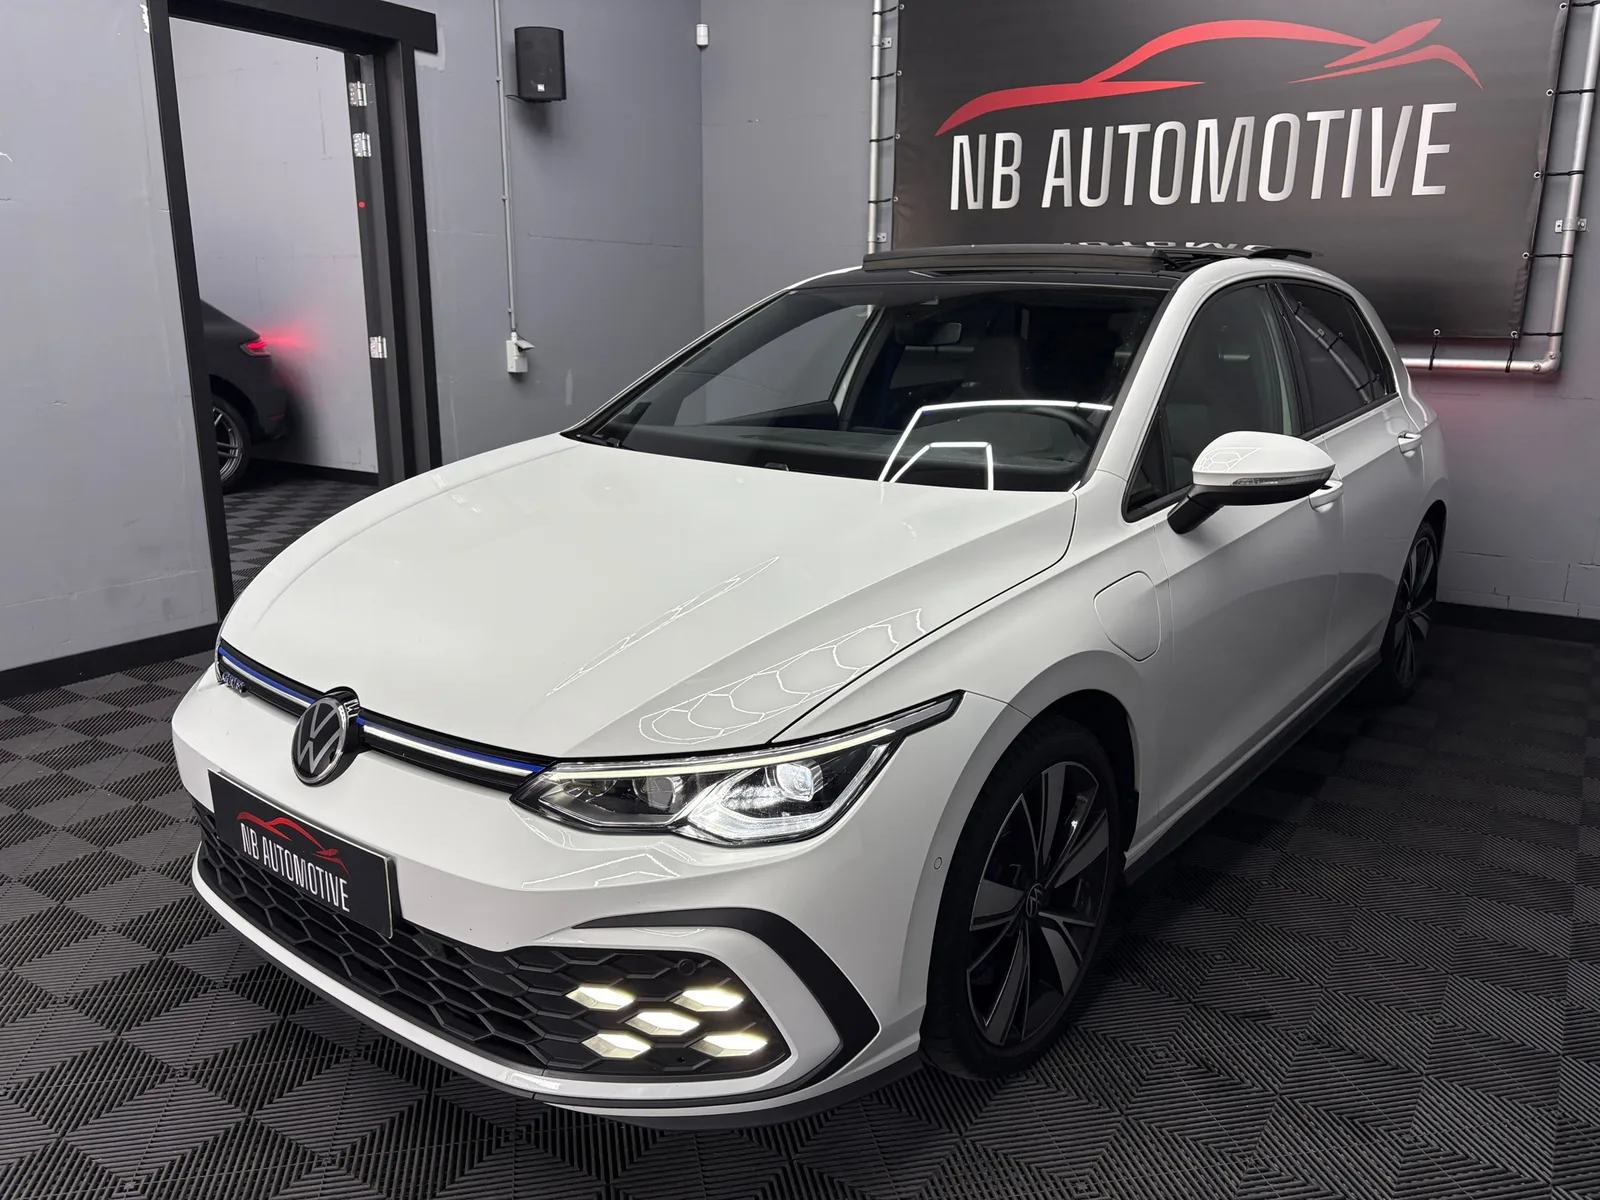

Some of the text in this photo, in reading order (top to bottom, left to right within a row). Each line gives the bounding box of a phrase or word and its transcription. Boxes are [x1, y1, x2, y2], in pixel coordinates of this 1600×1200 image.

[950, 102, 1458, 211] NB AUTOMOTIVE
[240, 822, 351, 913] NB AUTOMOTIVE
